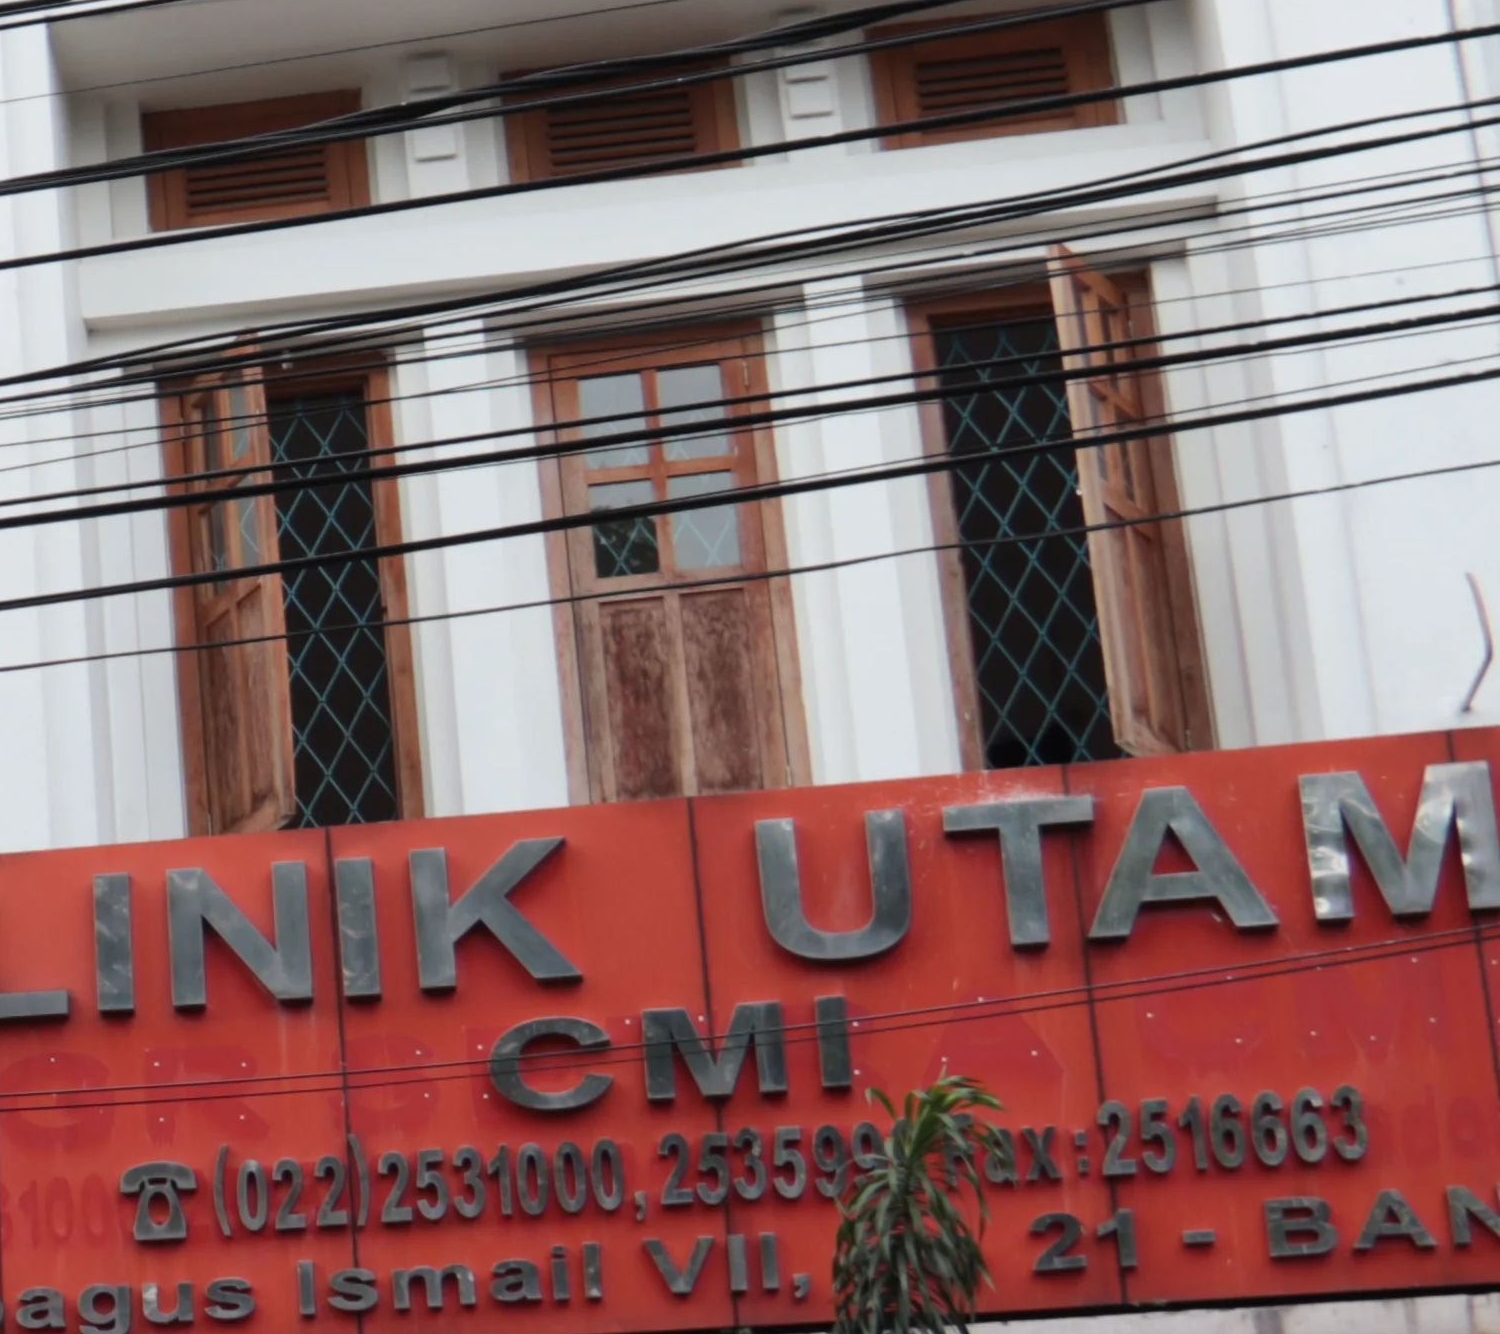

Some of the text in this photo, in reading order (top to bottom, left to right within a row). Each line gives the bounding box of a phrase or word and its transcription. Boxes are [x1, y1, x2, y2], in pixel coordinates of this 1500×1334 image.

[754, 760, 1500, 962] UTAM
[488, 995, 854, 1111] CMI
[297, 1241, 603, 1317] Ismail
[1029, 1209, 1139, 1273] 21
